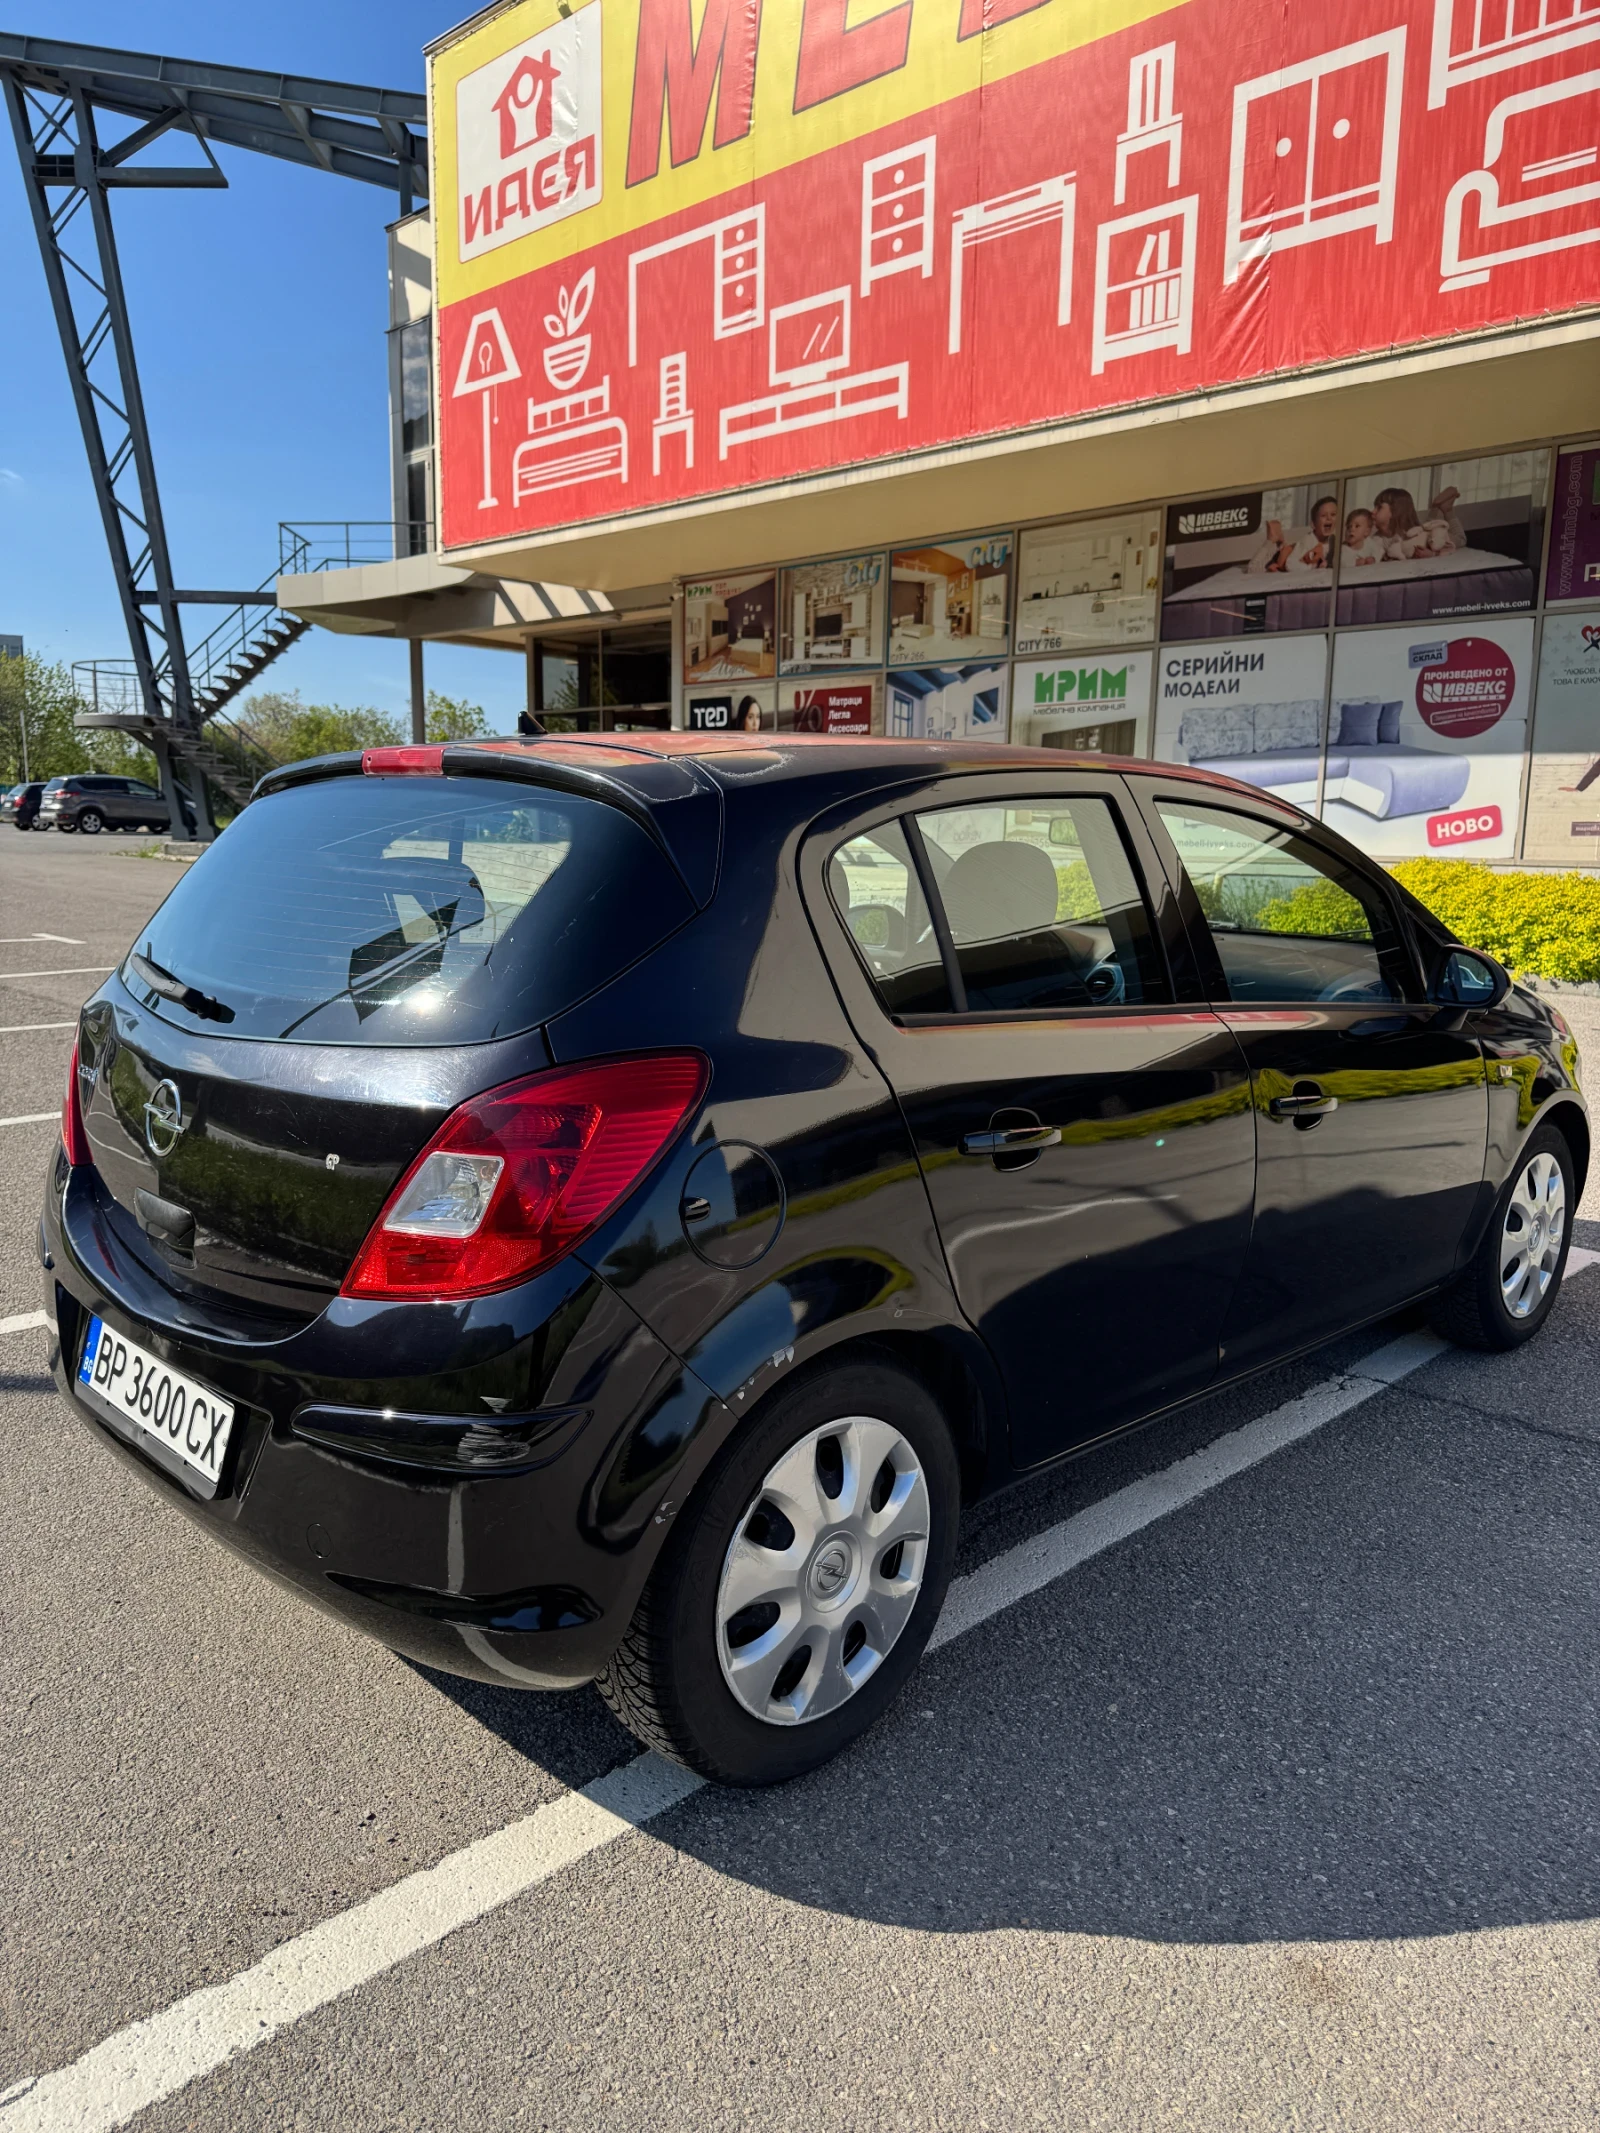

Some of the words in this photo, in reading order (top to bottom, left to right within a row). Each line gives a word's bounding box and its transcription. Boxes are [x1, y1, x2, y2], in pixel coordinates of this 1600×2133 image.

[464, 133, 595, 245] ИДЕЯ
[1196, 508, 1248, 527] ИВВЕКС
[965, 544, 1007, 569] City
[845, 560, 880, 588] City
[1432, 600, 1531, 614] www.mebeli-ivveks.com
[1017, 639, 1041, 652] CITY
[1043, 637, 1062, 649] 766
[1166, 650, 1265, 677] СЕРИЙНИ
[1413, 652, 1443, 663] СКЛАД
[1424, 669, 1493, 681] ПРОИЗВЕДЕНО
[1495, 667, 1508, 677] ОТ
[1034, 666, 1127, 703] ИРИМ
[1164, 679, 1240, 699] МОДЕЛИ
[1444, 681, 1507, 696] ИВВЕКС
[828, 696, 862, 708] Матраци
[828, 709, 851, 720] Легла
[828, 723, 869, 735] Аксесоари
[1436, 815, 1494, 839] НОВО
[82, 1356, 93, 1374] BG
[94, 1332, 127, 1391] BP
[124, 1355, 186, 1438] 3600
[186, 1397, 227, 1470] CX
